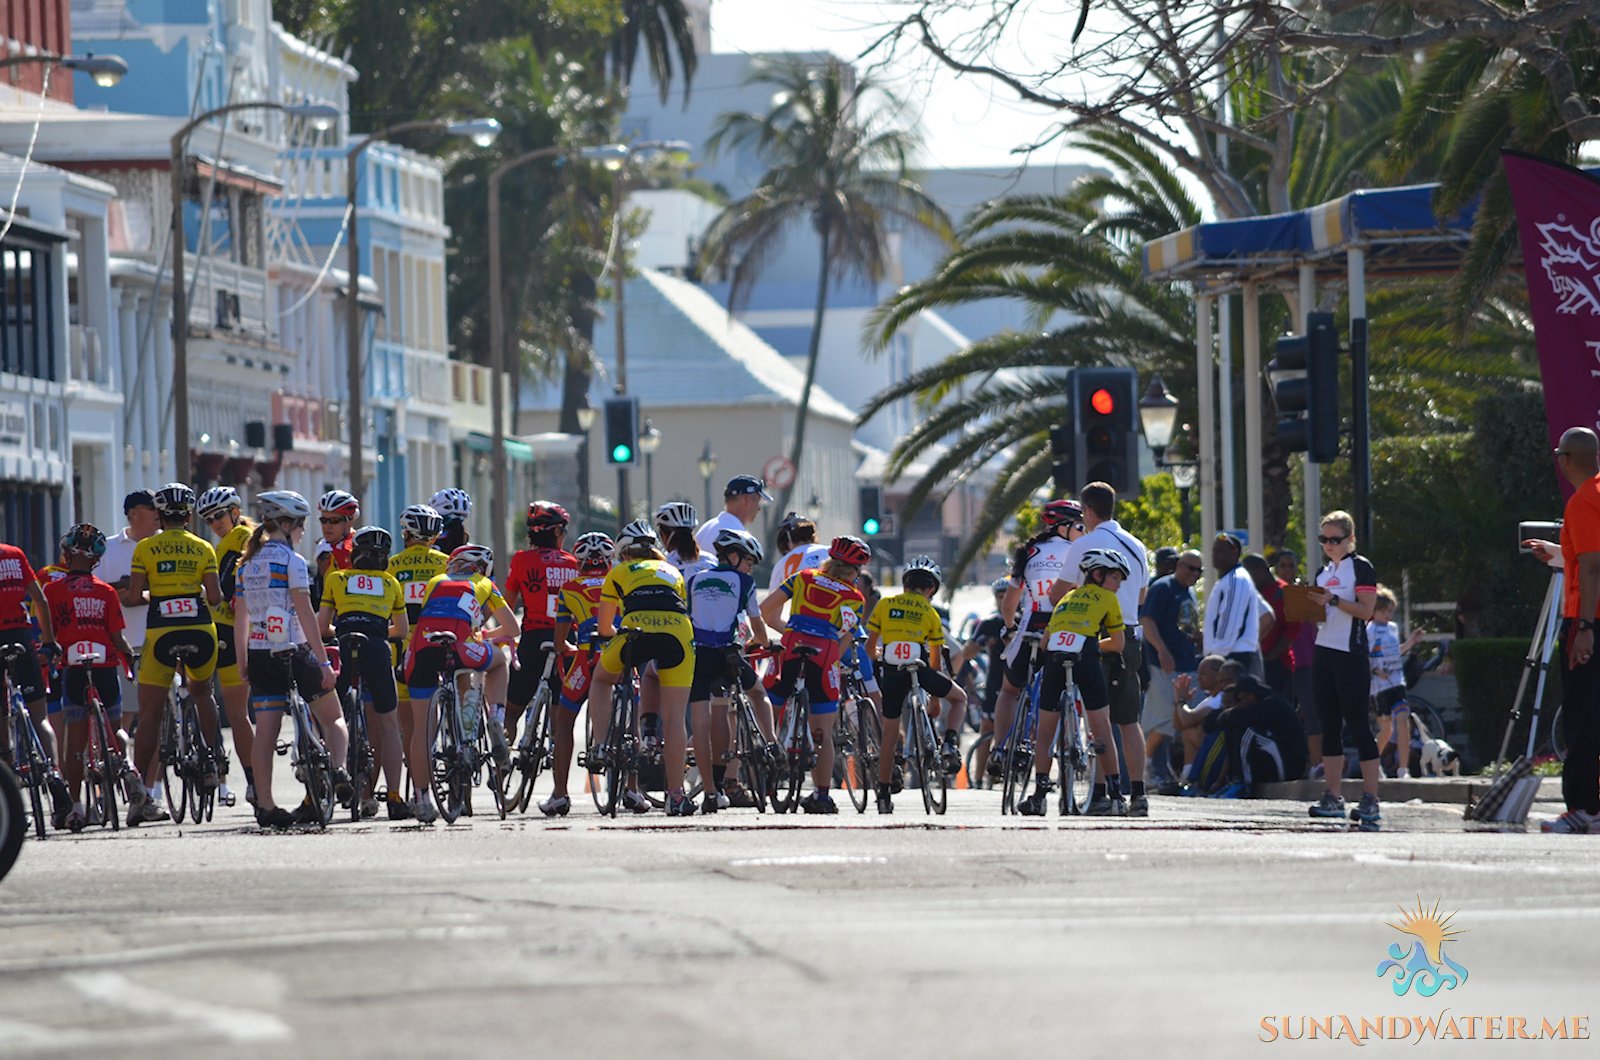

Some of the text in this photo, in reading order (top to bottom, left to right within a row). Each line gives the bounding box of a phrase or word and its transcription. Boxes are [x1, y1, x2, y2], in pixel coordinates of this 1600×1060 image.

[150, 544, 204, 556] WORKS
[177, 560, 198, 568] FAST
[391, 556, 443, 567] WORKS
[73, 597, 106, 611] CRIME
[166, 600, 192, 615] 135
[267, 615, 284, 633] 53
[630, 615, 682, 626] WORKS
[1057, 632, 1076, 646] 50
[894, 643, 911, 659] 49
